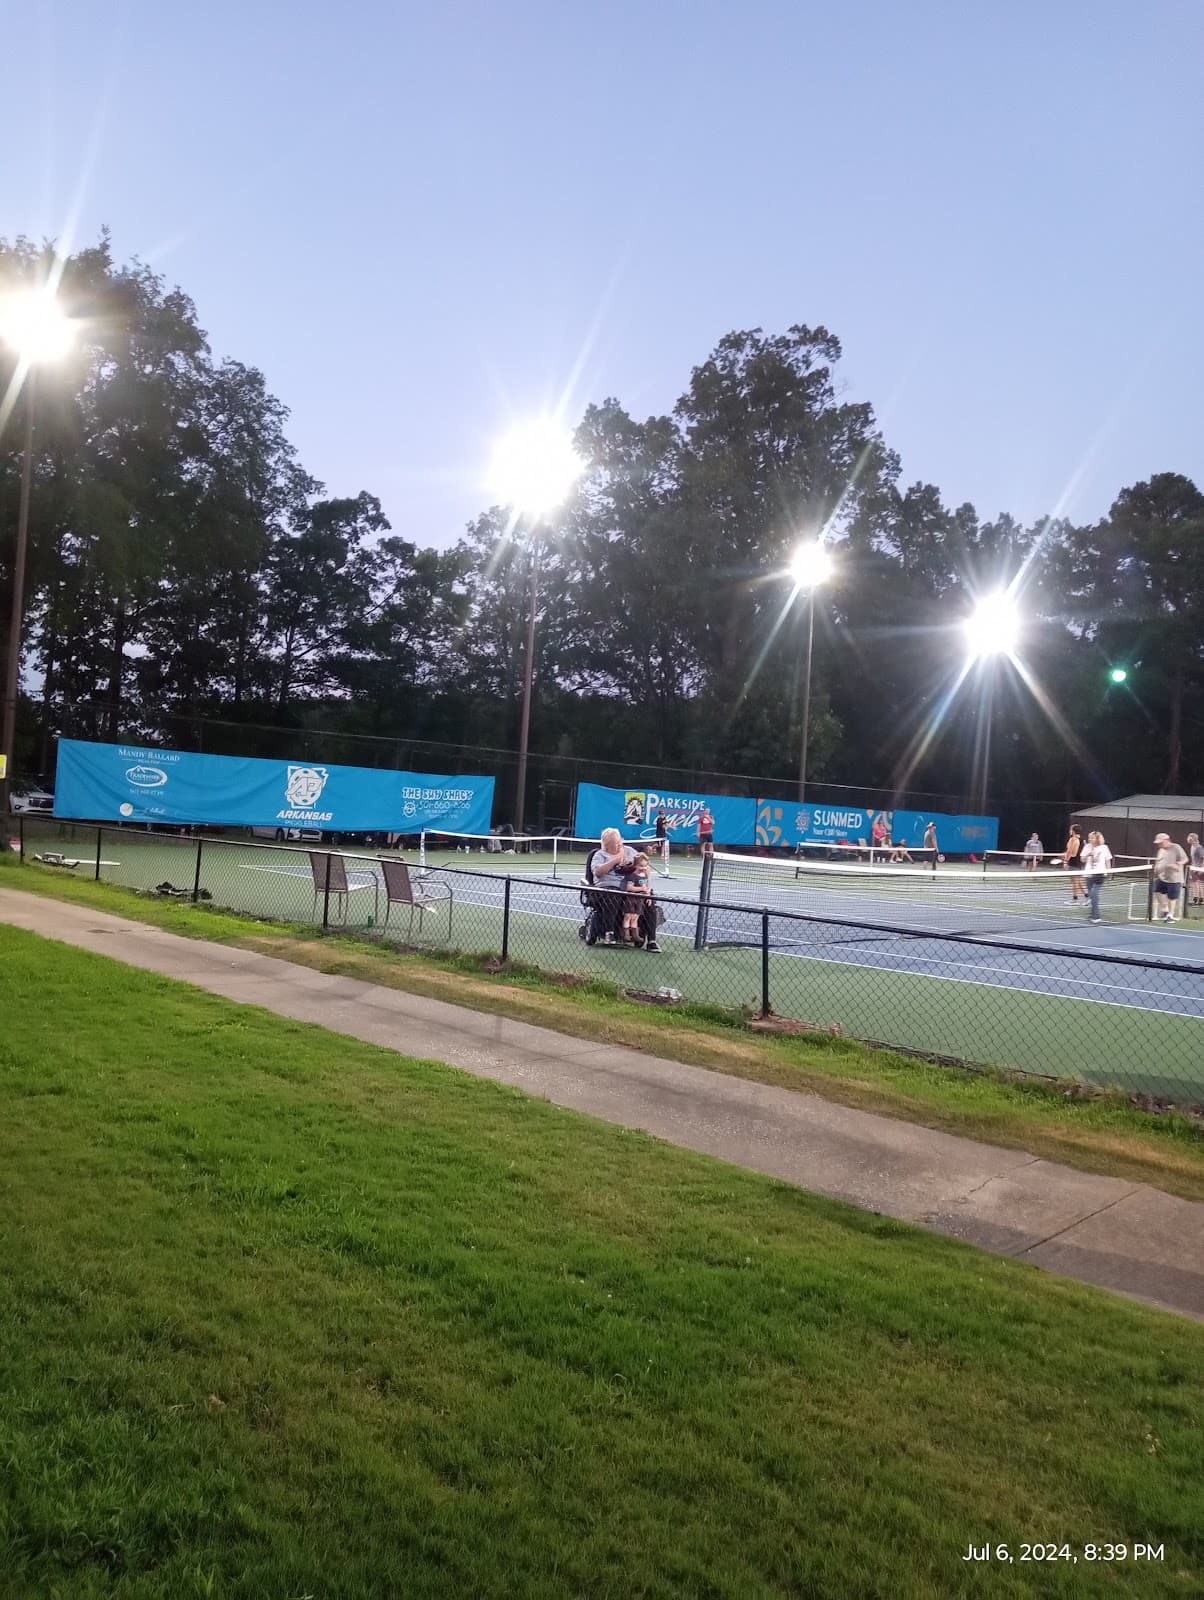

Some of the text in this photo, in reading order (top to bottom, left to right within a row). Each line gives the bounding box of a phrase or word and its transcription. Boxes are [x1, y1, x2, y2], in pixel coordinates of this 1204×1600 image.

[402, 787, 421, 800] THE
[276, 810, 333, 821] ARKANSAS
[645, 792, 706, 825] PARKSIDE
[813, 809, 863, 829] SUNMED
